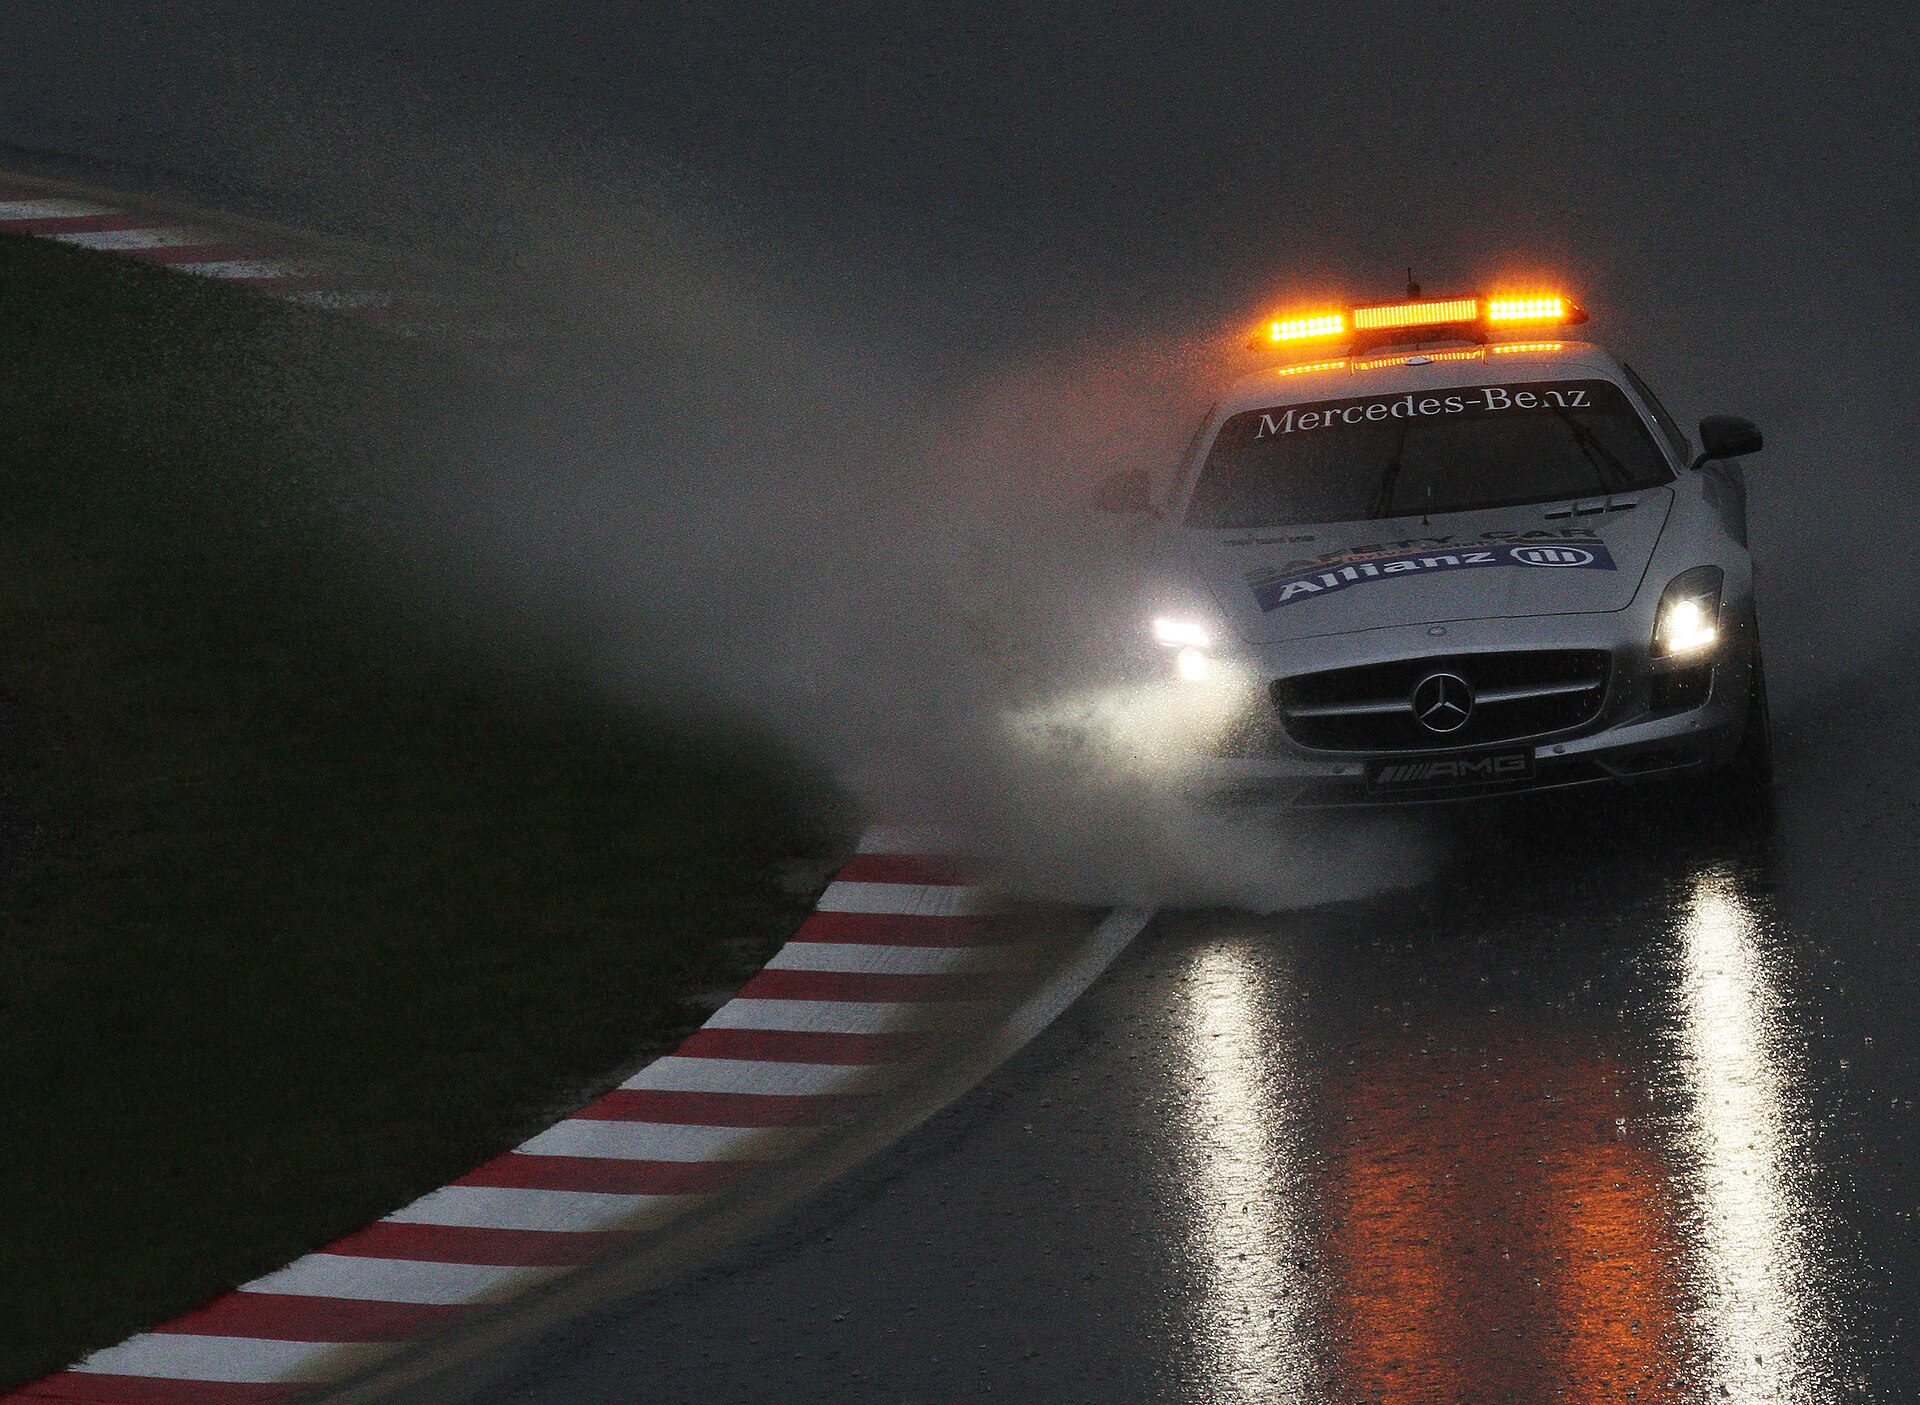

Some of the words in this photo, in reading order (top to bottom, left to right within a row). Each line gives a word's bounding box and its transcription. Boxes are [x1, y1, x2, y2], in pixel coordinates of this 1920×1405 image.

[1254, 386, 1591, 439] Mercedes-Benz
[1480, 527, 1599, 539] CAR
[1278, 550, 1496, 602] Allianz
